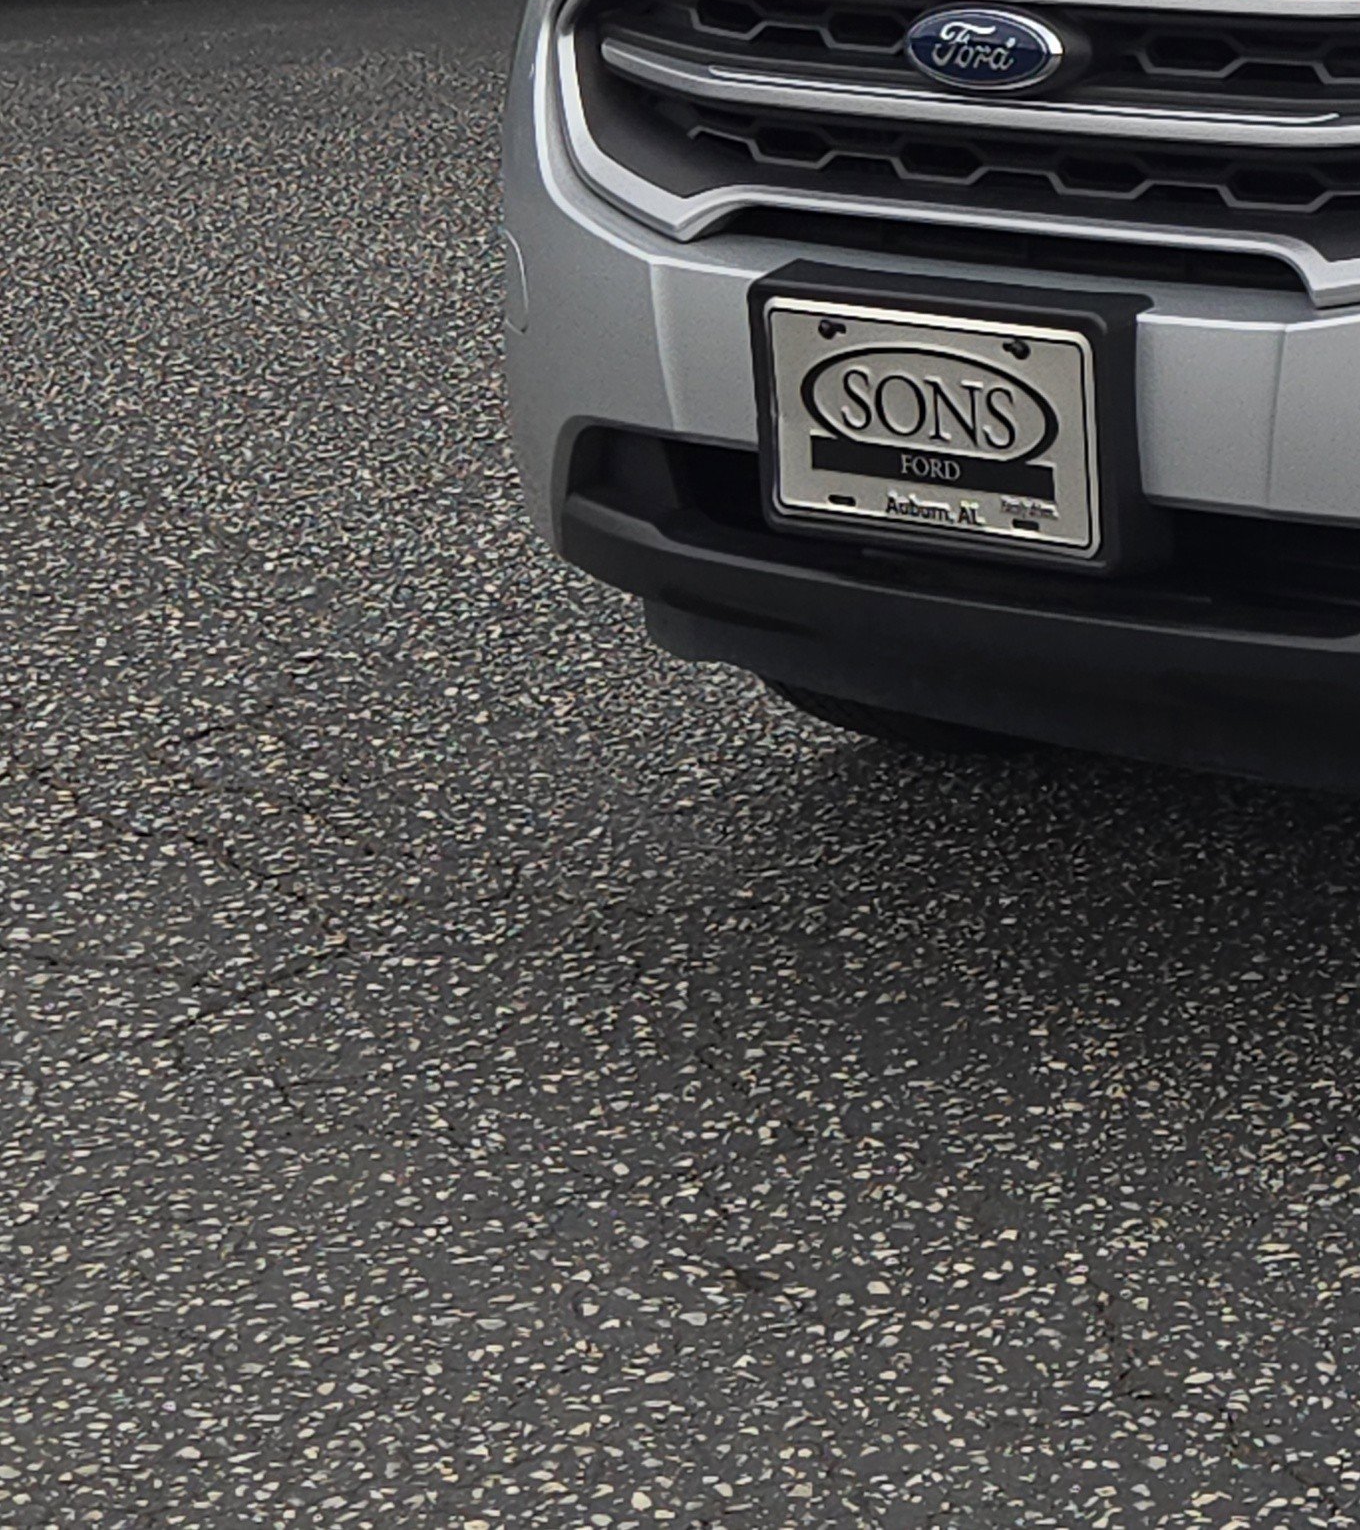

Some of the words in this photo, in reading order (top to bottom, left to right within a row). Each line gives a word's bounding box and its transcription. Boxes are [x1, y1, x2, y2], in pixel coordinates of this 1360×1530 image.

[931, 21, 1014, 70] Ford
[840, 367, 1017, 449] SONS
[901, 455, 960, 481] FORD
